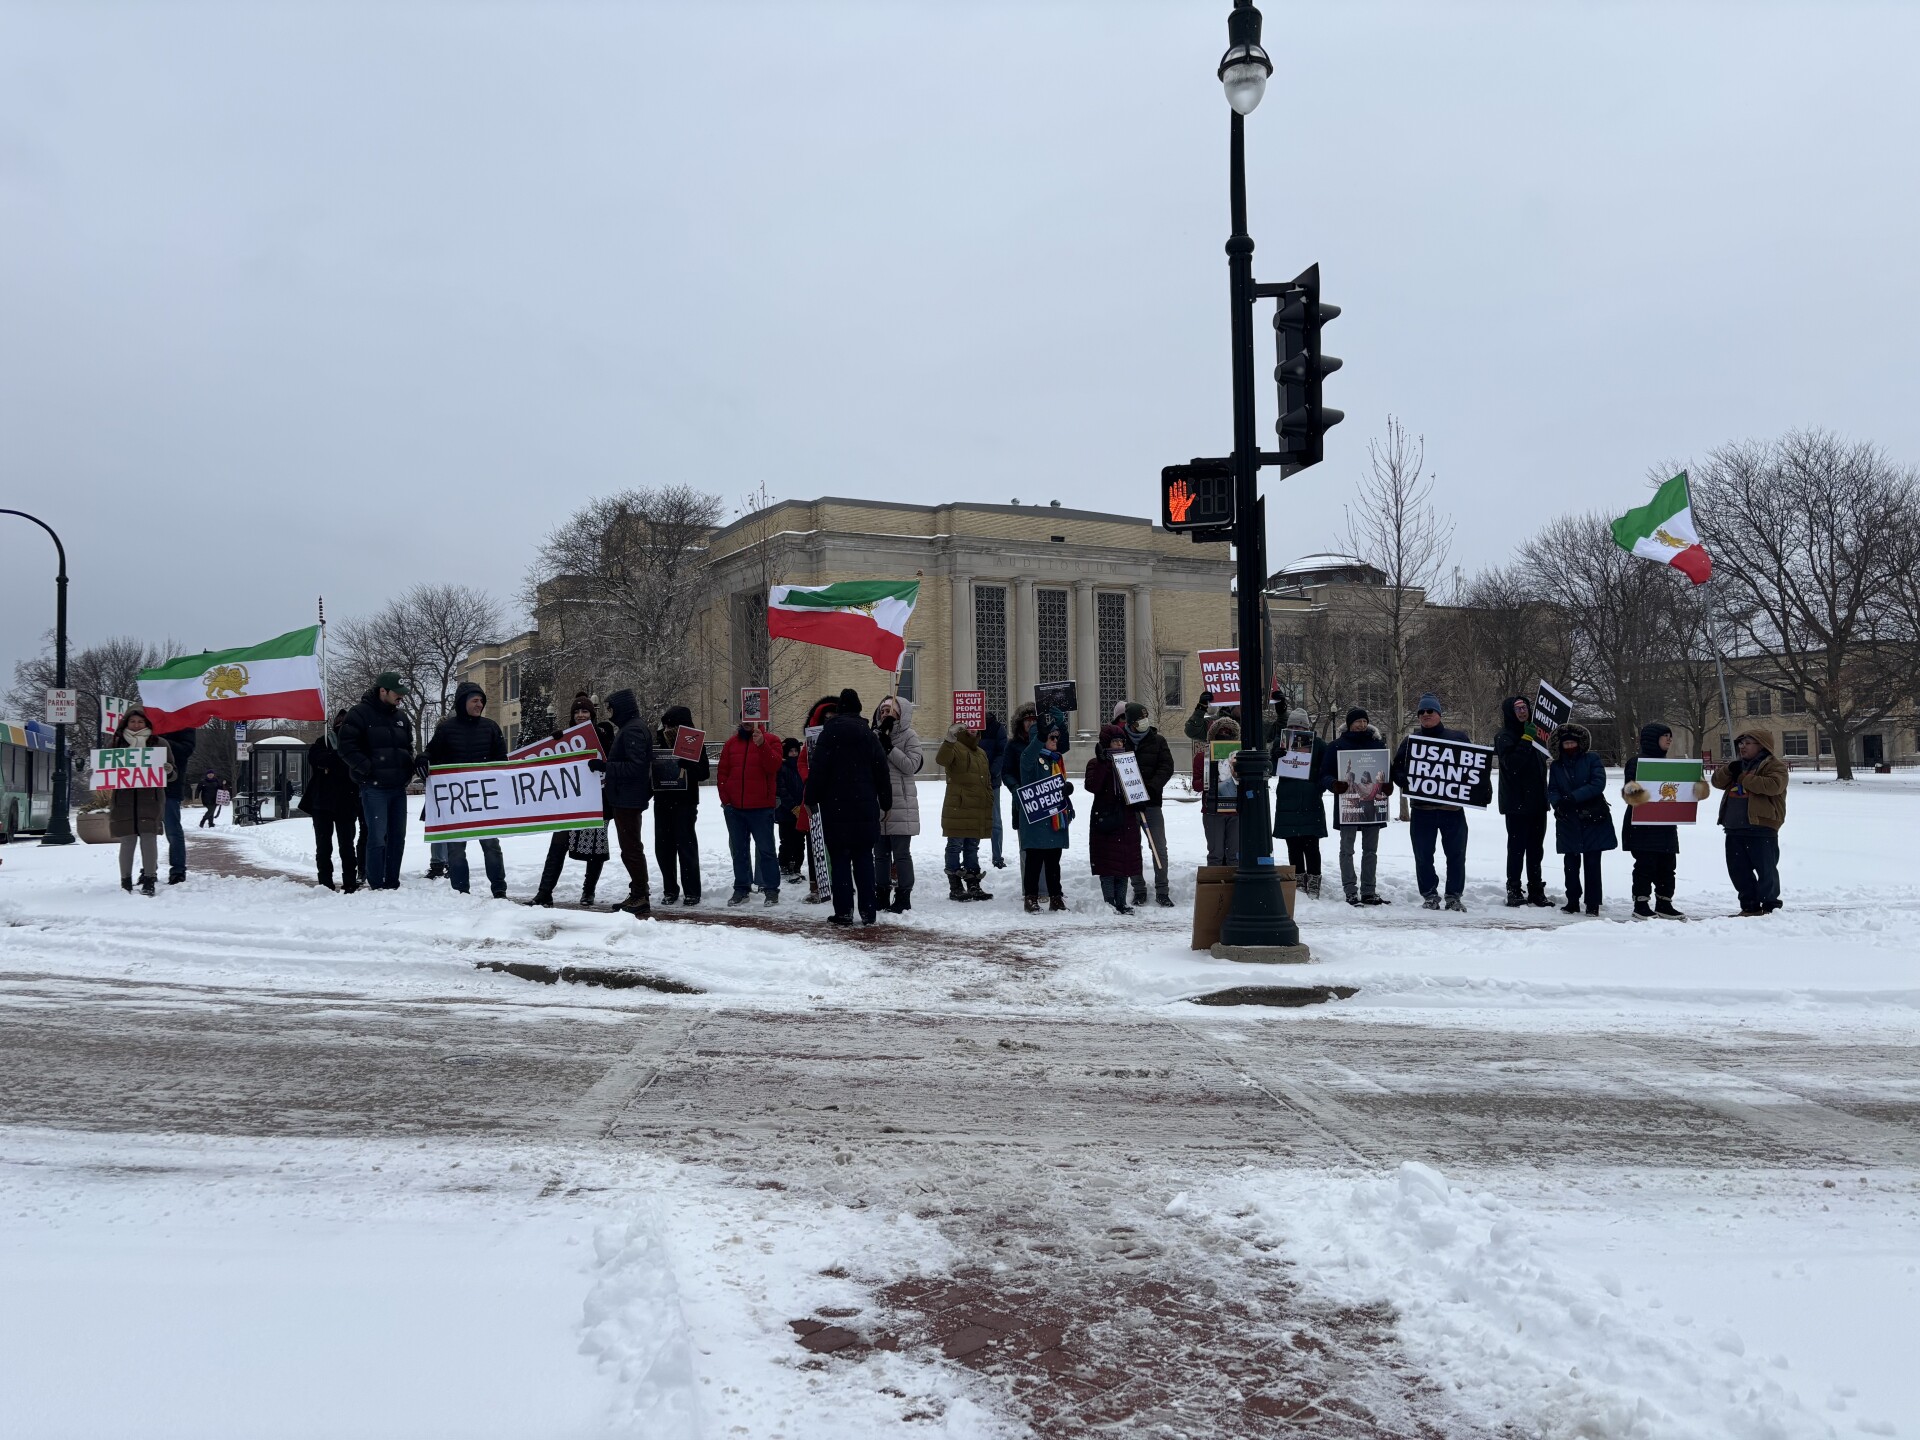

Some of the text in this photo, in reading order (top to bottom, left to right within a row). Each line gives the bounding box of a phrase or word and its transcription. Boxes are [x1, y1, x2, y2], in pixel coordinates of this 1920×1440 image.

[996, 557, 1117, 575] AUDITORIUM
[1205, 673, 1219, 682] OF
[1206, 684, 1221, 693] IN
[1538, 694, 1558, 715] CALL IT
[1535, 708, 1552, 728] WHAT
[99, 747, 154, 769] FREE
[1114, 756, 1136, 764] PROTEST
[1411, 743, 1487, 769] USA BE
[96, 767, 164, 790] IRAN
[1408, 760, 1480, 785] IRAN'S
[433, 778, 499, 818] FREE
[511, 765, 581, 806] IRAN
[1021, 777, 1065, 800] NO JUSTICE
[1124, 779, 1142, 787] HUMAN
[1407, 776, 1472, 800] VOICE
[1130, 792, 1145, 800] RIGHT
[1025, 800, 1039, 814] NO
